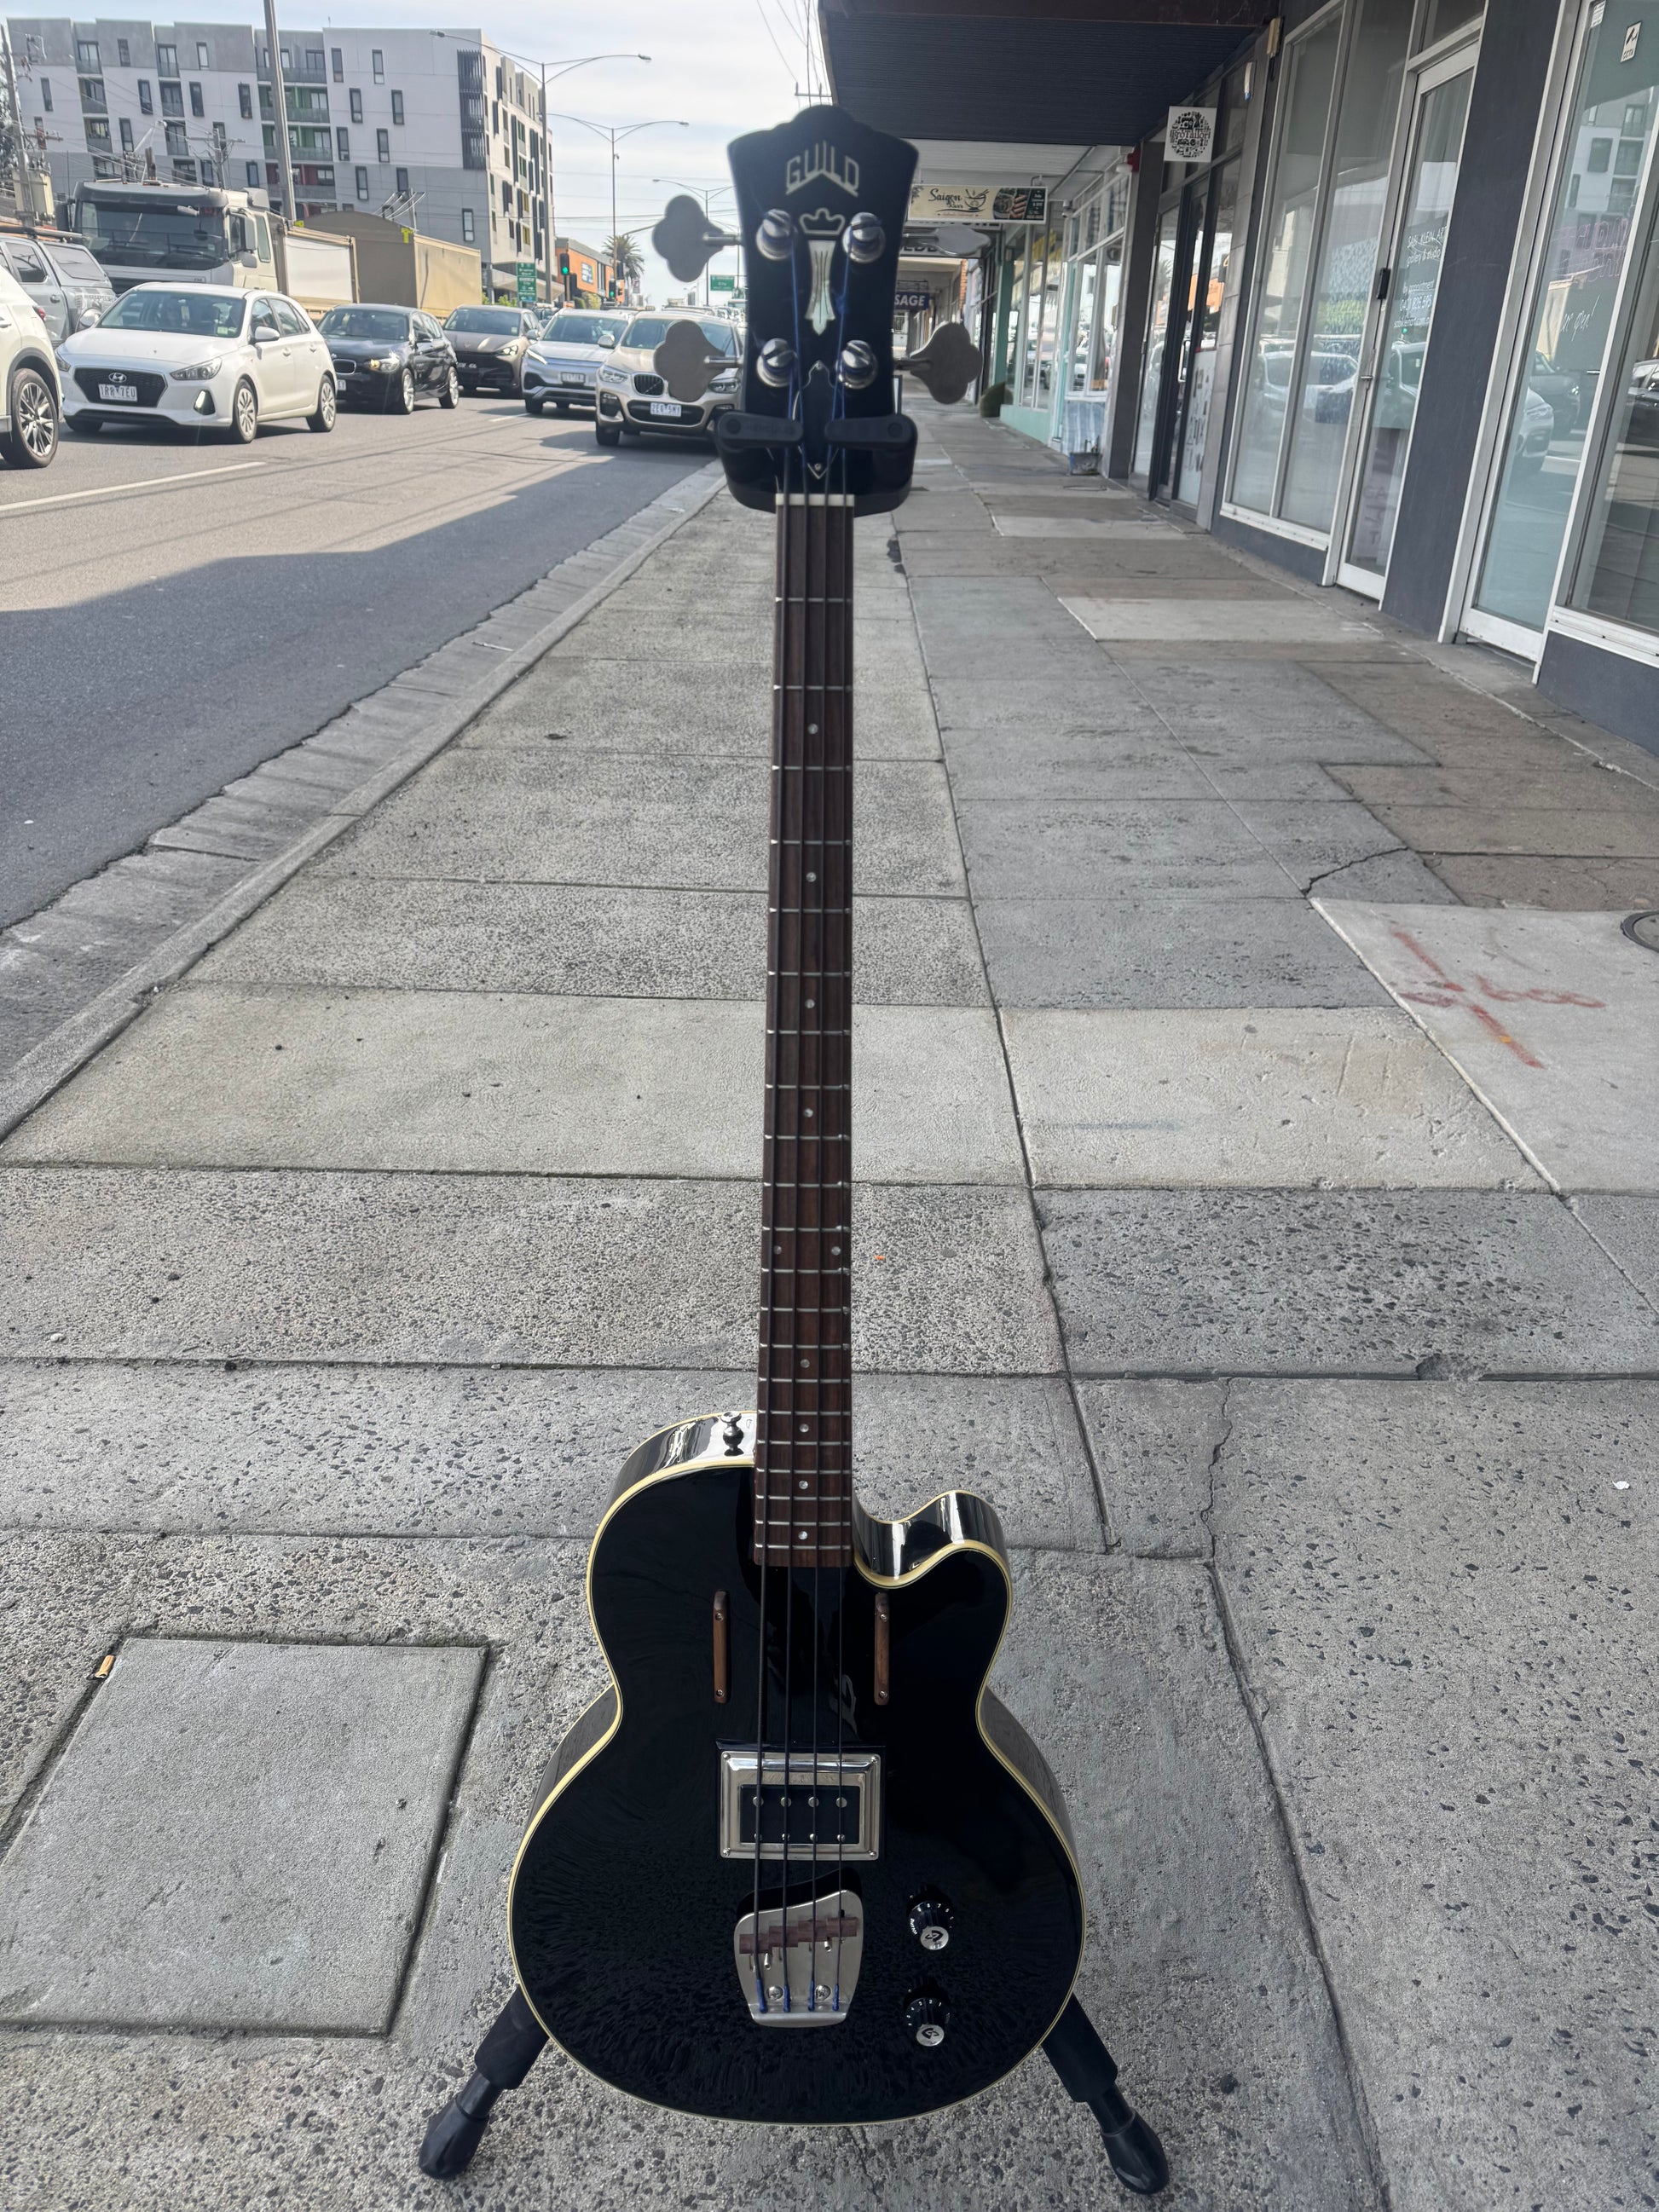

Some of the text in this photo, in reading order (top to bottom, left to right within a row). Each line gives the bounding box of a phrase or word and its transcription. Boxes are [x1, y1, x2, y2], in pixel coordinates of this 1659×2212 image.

[786, 140, 859, 197] GUILD
[928, 188, 962, 205] Saigon
[894, 293, 926, 306] SAGE
